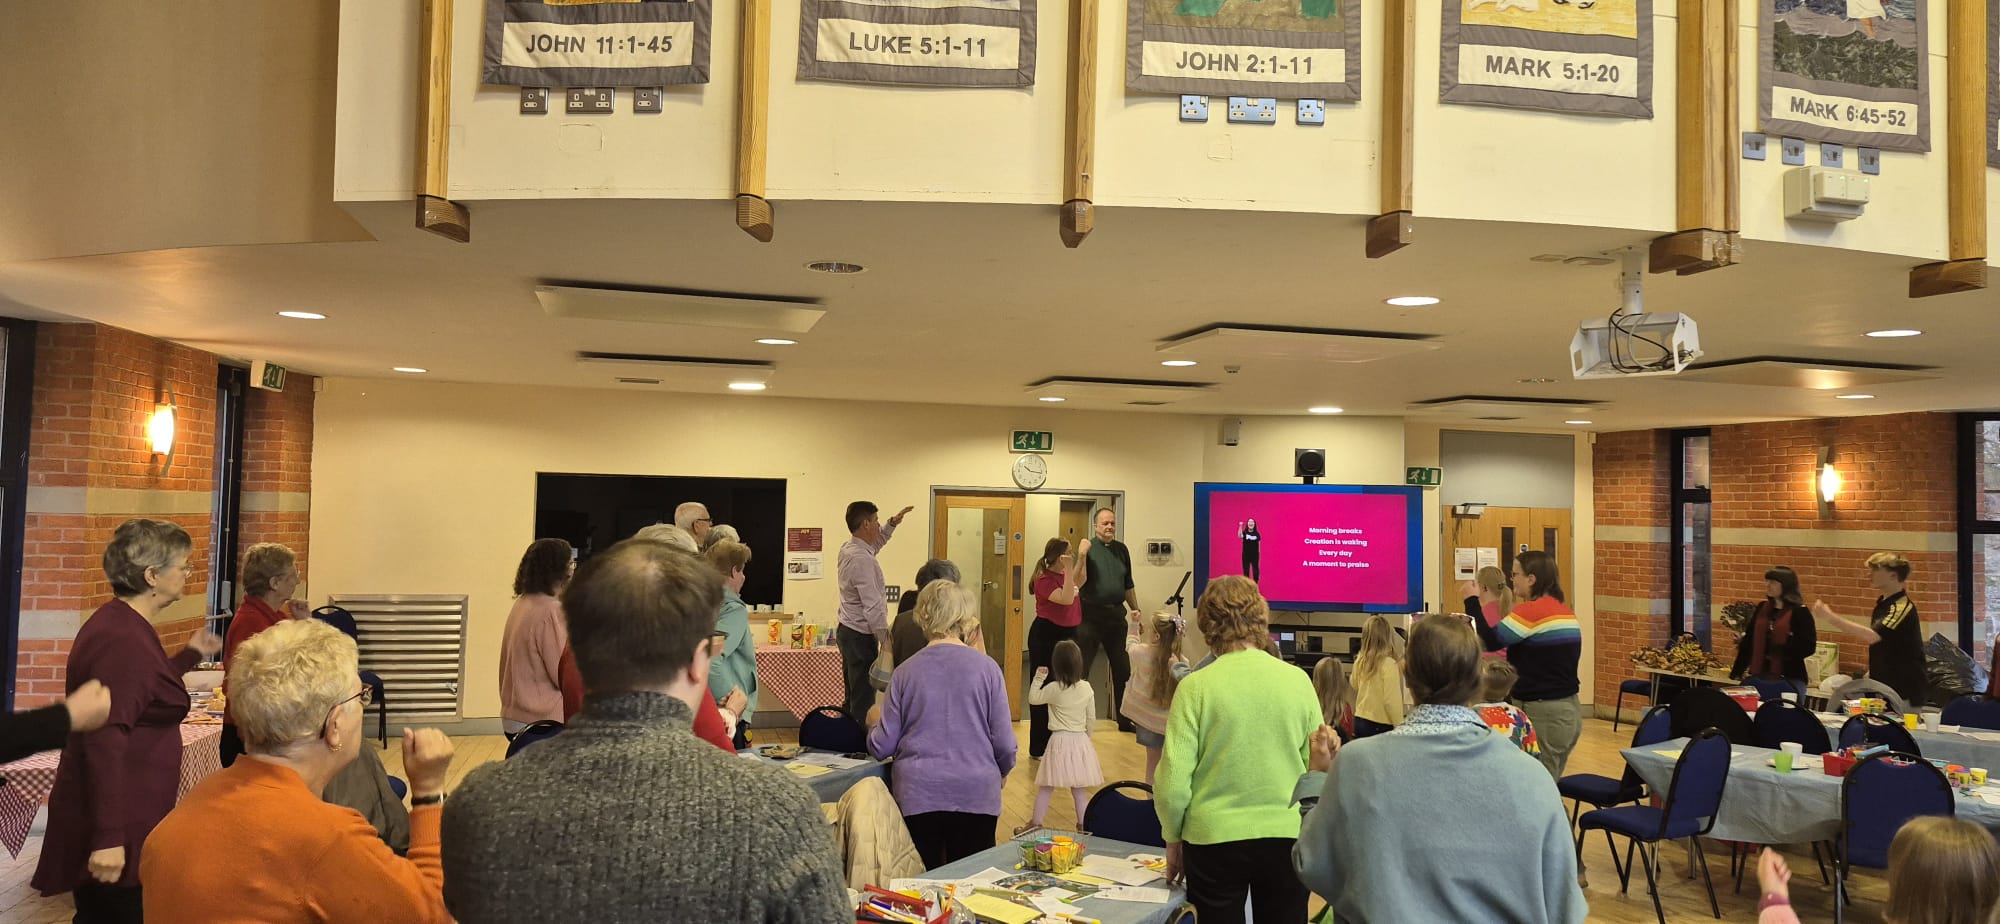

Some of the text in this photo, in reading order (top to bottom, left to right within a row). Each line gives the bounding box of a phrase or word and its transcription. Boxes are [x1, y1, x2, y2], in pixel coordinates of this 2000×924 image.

[526, 34, 673, 54] JOHN 11:1-45
[849, 32, 986, 57] LUKE 5:1-11
[1176, 51, 1312, 75] JOHN 2:1-11
[1485, 55, 1620, 83] MARK 5:1-20
[1790, 96, 1906, 127] MARK 6:45-52
[1309, 527, 1338, 535] Morning
[1319, 549, 1338, 557] Every
[1342, 539, 1368, 547] waking
